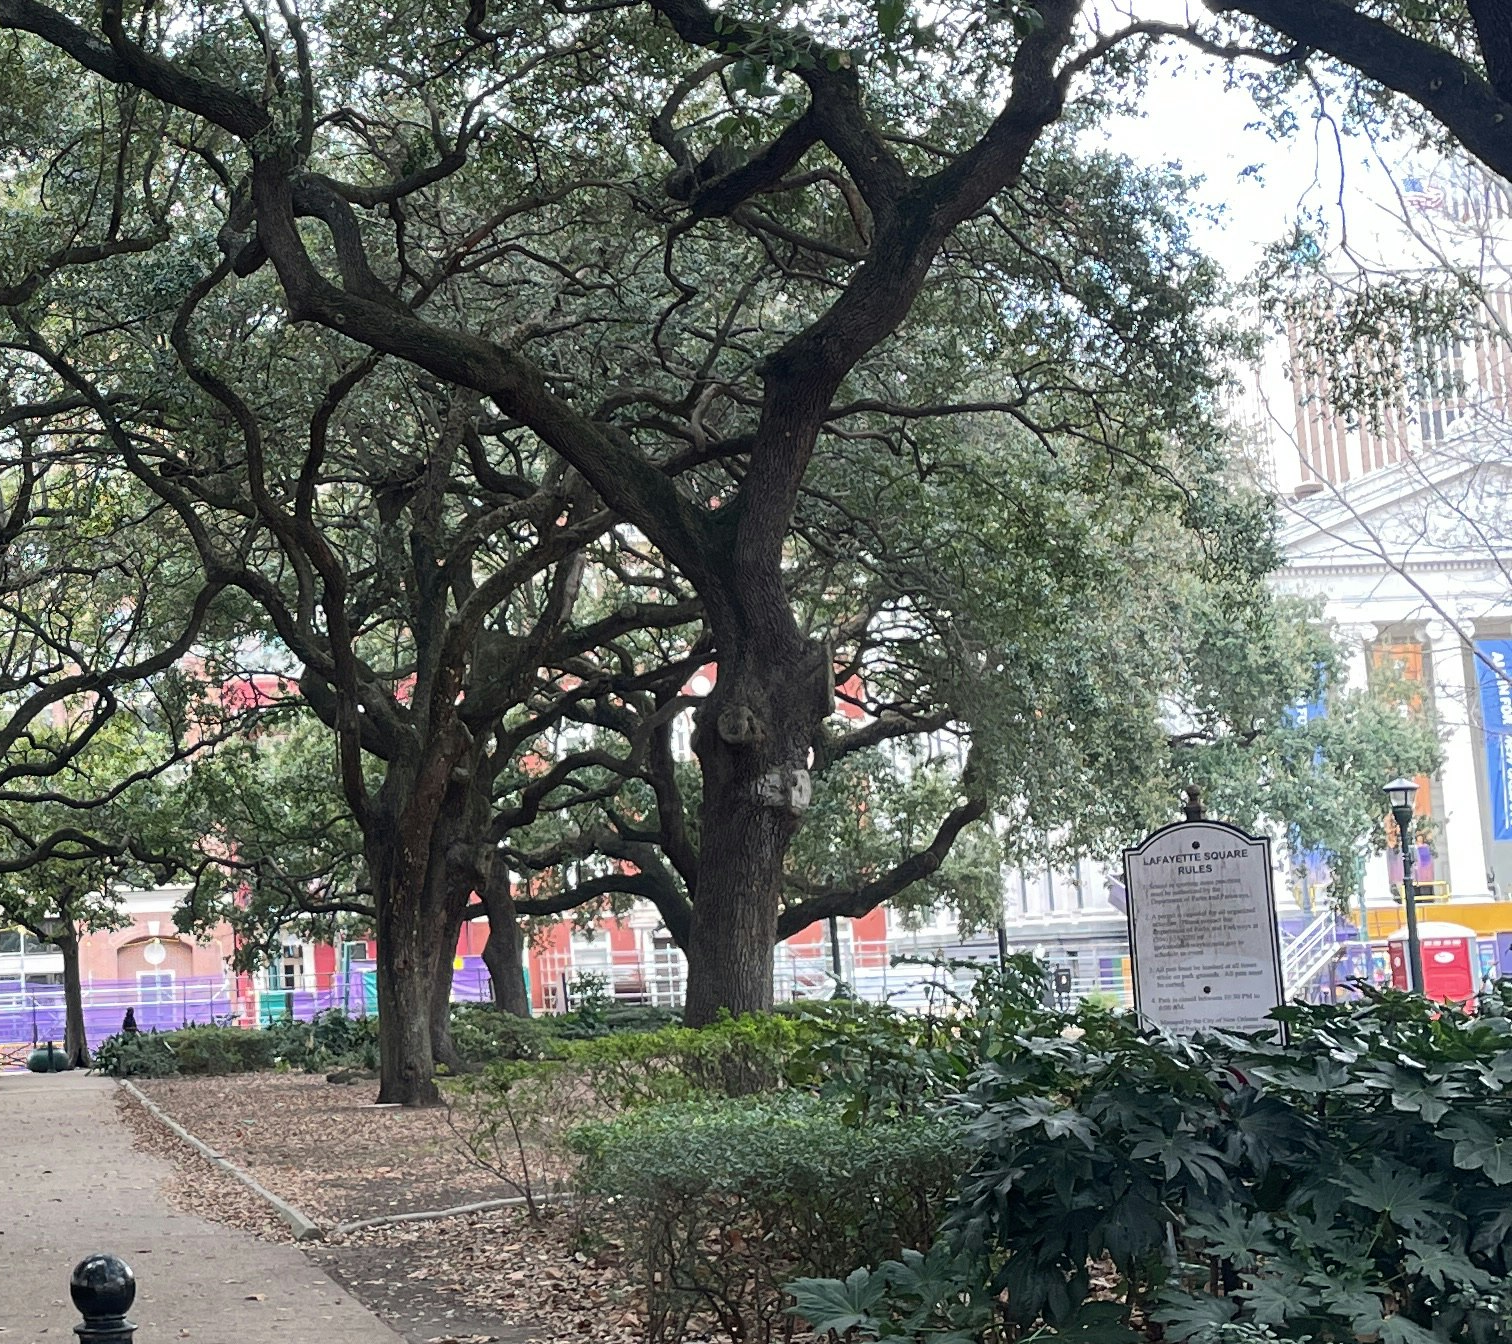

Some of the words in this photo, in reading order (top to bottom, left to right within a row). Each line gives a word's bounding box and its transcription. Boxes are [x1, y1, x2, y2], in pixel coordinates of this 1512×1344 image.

[1143, 853, 1201, 866] LAFAYETTE
[1204, 849, 1248, 861] SQUARE
[1178, 864, 1213, 875] RULES
